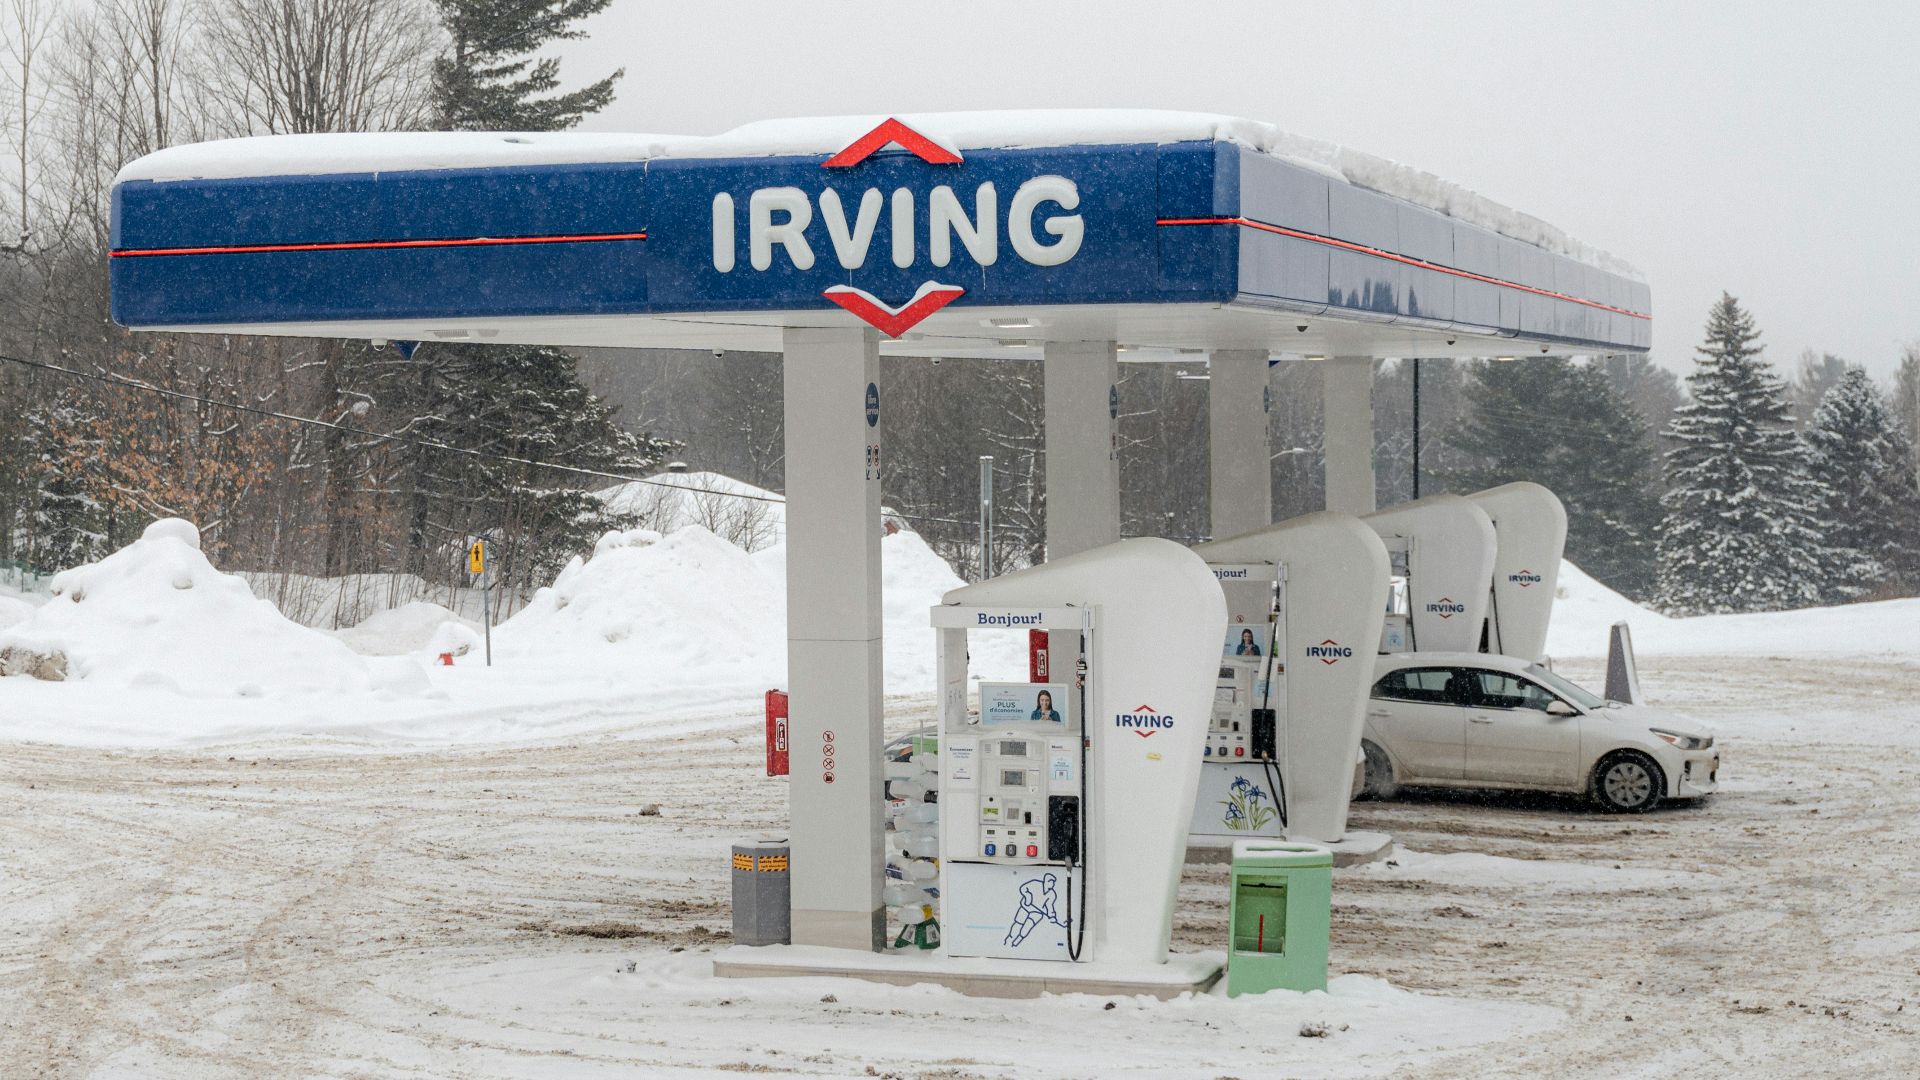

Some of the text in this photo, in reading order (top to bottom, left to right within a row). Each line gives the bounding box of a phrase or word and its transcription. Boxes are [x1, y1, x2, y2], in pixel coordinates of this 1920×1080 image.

[712, 174, 1085, 273] IRVING
[1212, 568, 1247, 580] njour!
[1509, 574, 1541, 583] IRVING
[1426, 604, 1465, 613] IRVING
[977, 612, 1043, 627] Bonjour!
[1306, 646, 1353, 658] IRVING
[1115, 714, 1174, 728] IRVING
